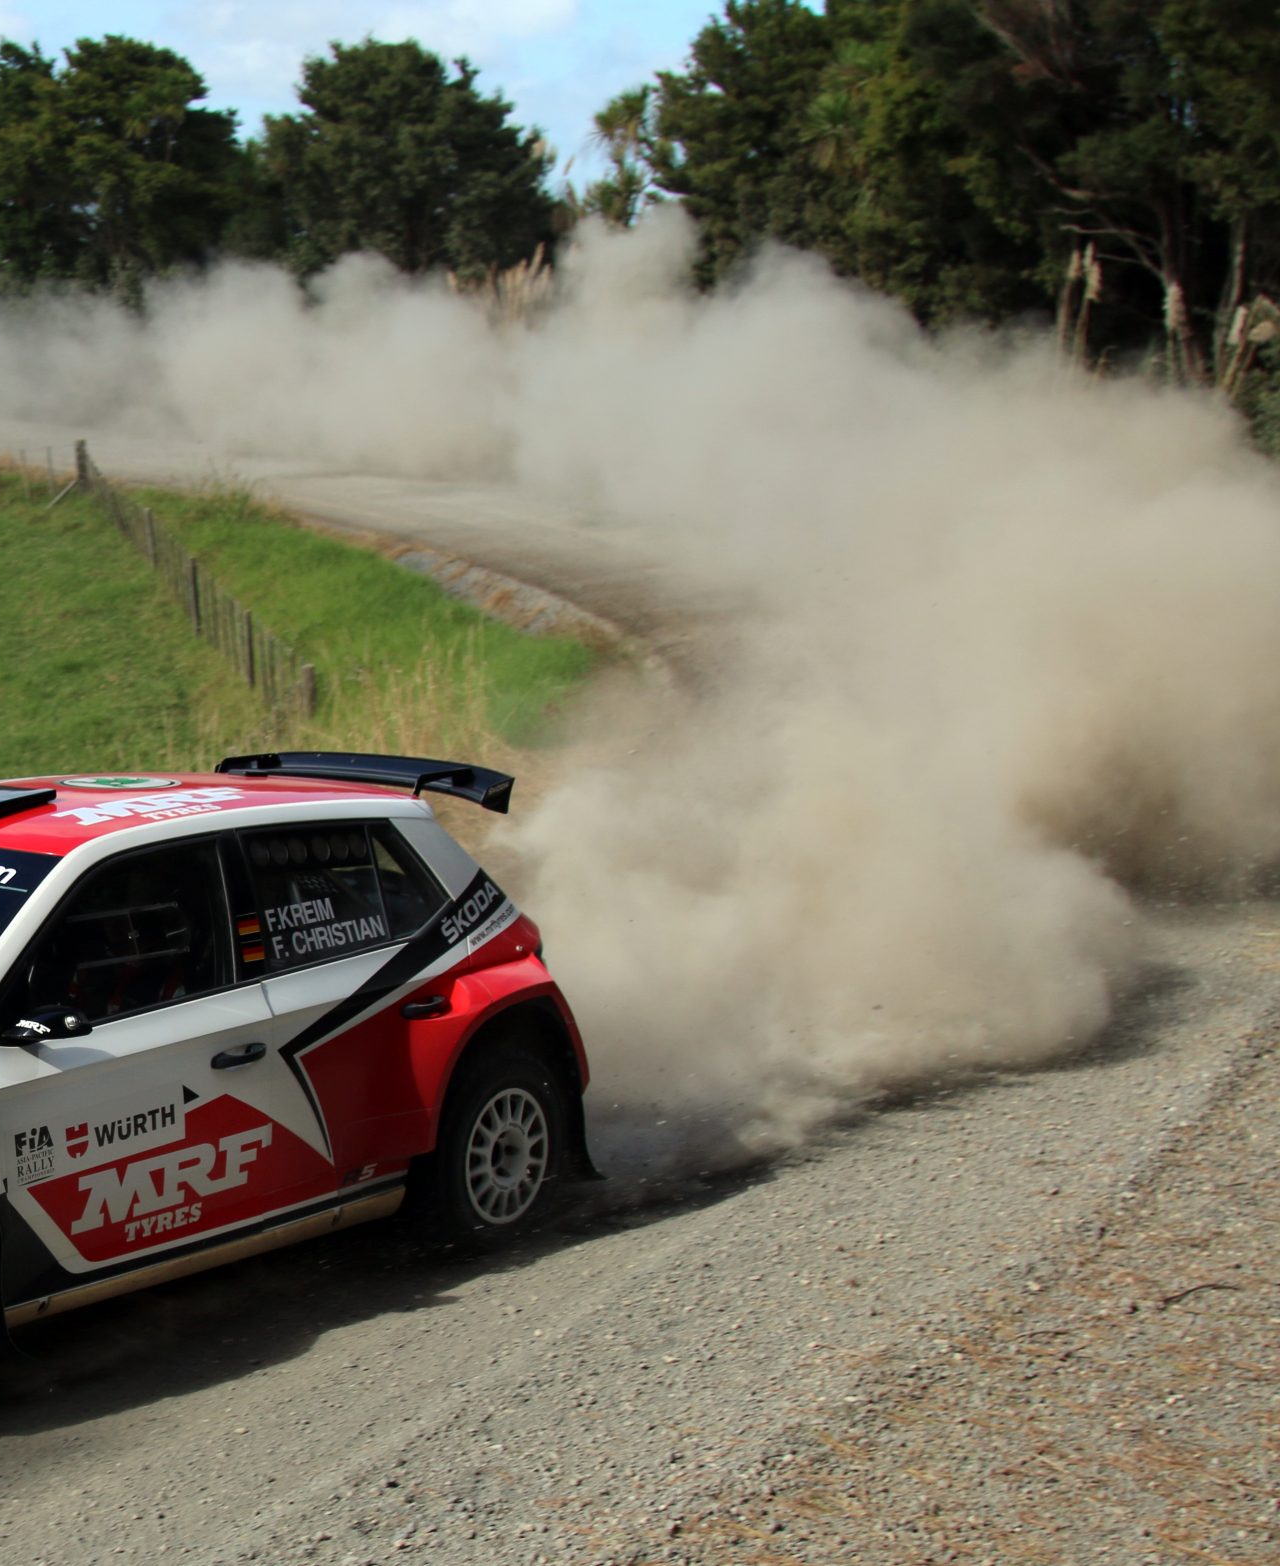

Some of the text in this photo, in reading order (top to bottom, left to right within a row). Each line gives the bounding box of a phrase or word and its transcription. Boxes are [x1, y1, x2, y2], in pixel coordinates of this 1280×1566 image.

[51, 786, 246, 826] MRF
[140, 803, 223, 820] TYRES
[264, 897, 336, 932] F.KREIM
[440, 881, 500, 944] ŠKODA
[271, 914, 386, 959] F. CHRISTIAN
[16, 1019, 51, 1034] MRF
[16, 1155, 55, 1178] RALLY
[70, 1122, 273, 1236] MRF
[125, 1202, 203, 1243] TYRES
